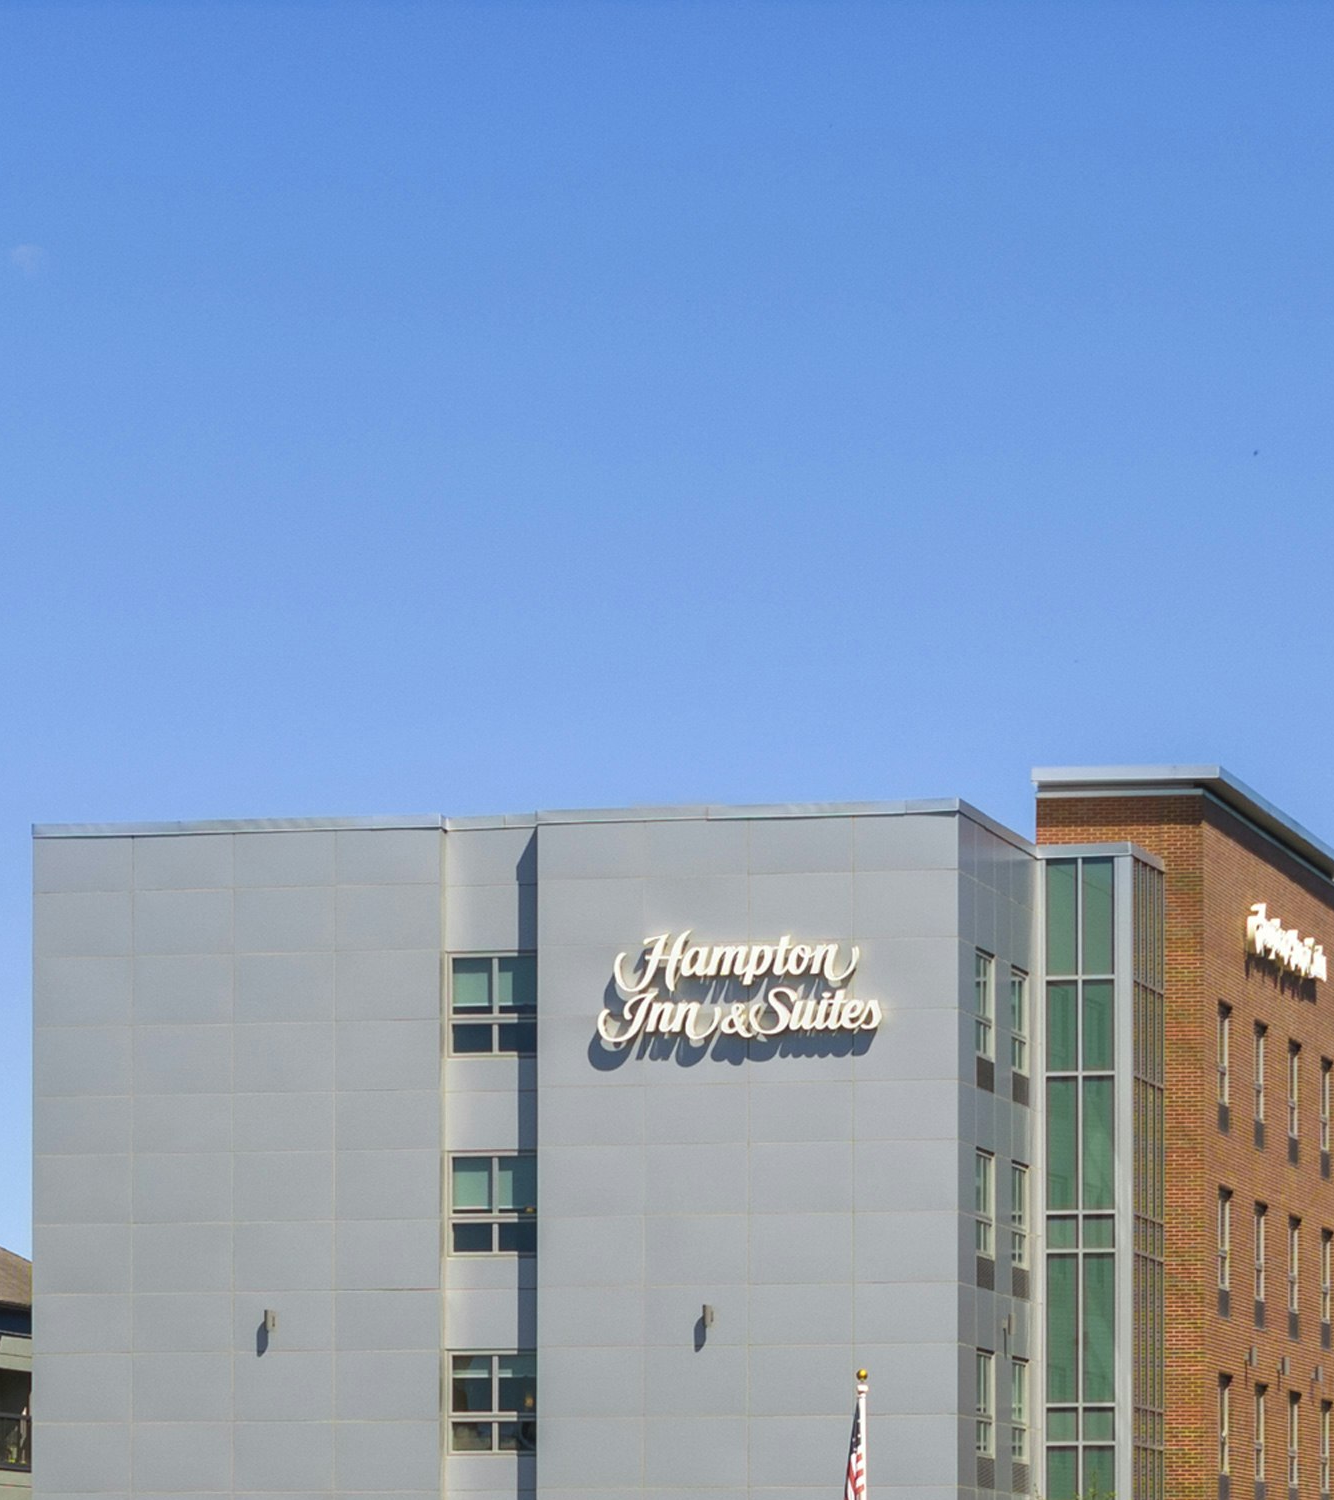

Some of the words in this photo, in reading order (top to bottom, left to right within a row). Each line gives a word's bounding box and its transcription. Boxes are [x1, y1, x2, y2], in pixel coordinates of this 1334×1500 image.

[613, 929, 860, 992] Hampton
[597, 988, 722, 1042] Inn
[721, 1002, 753, 1038] &
[749, 986, 883, 1035] Suites
